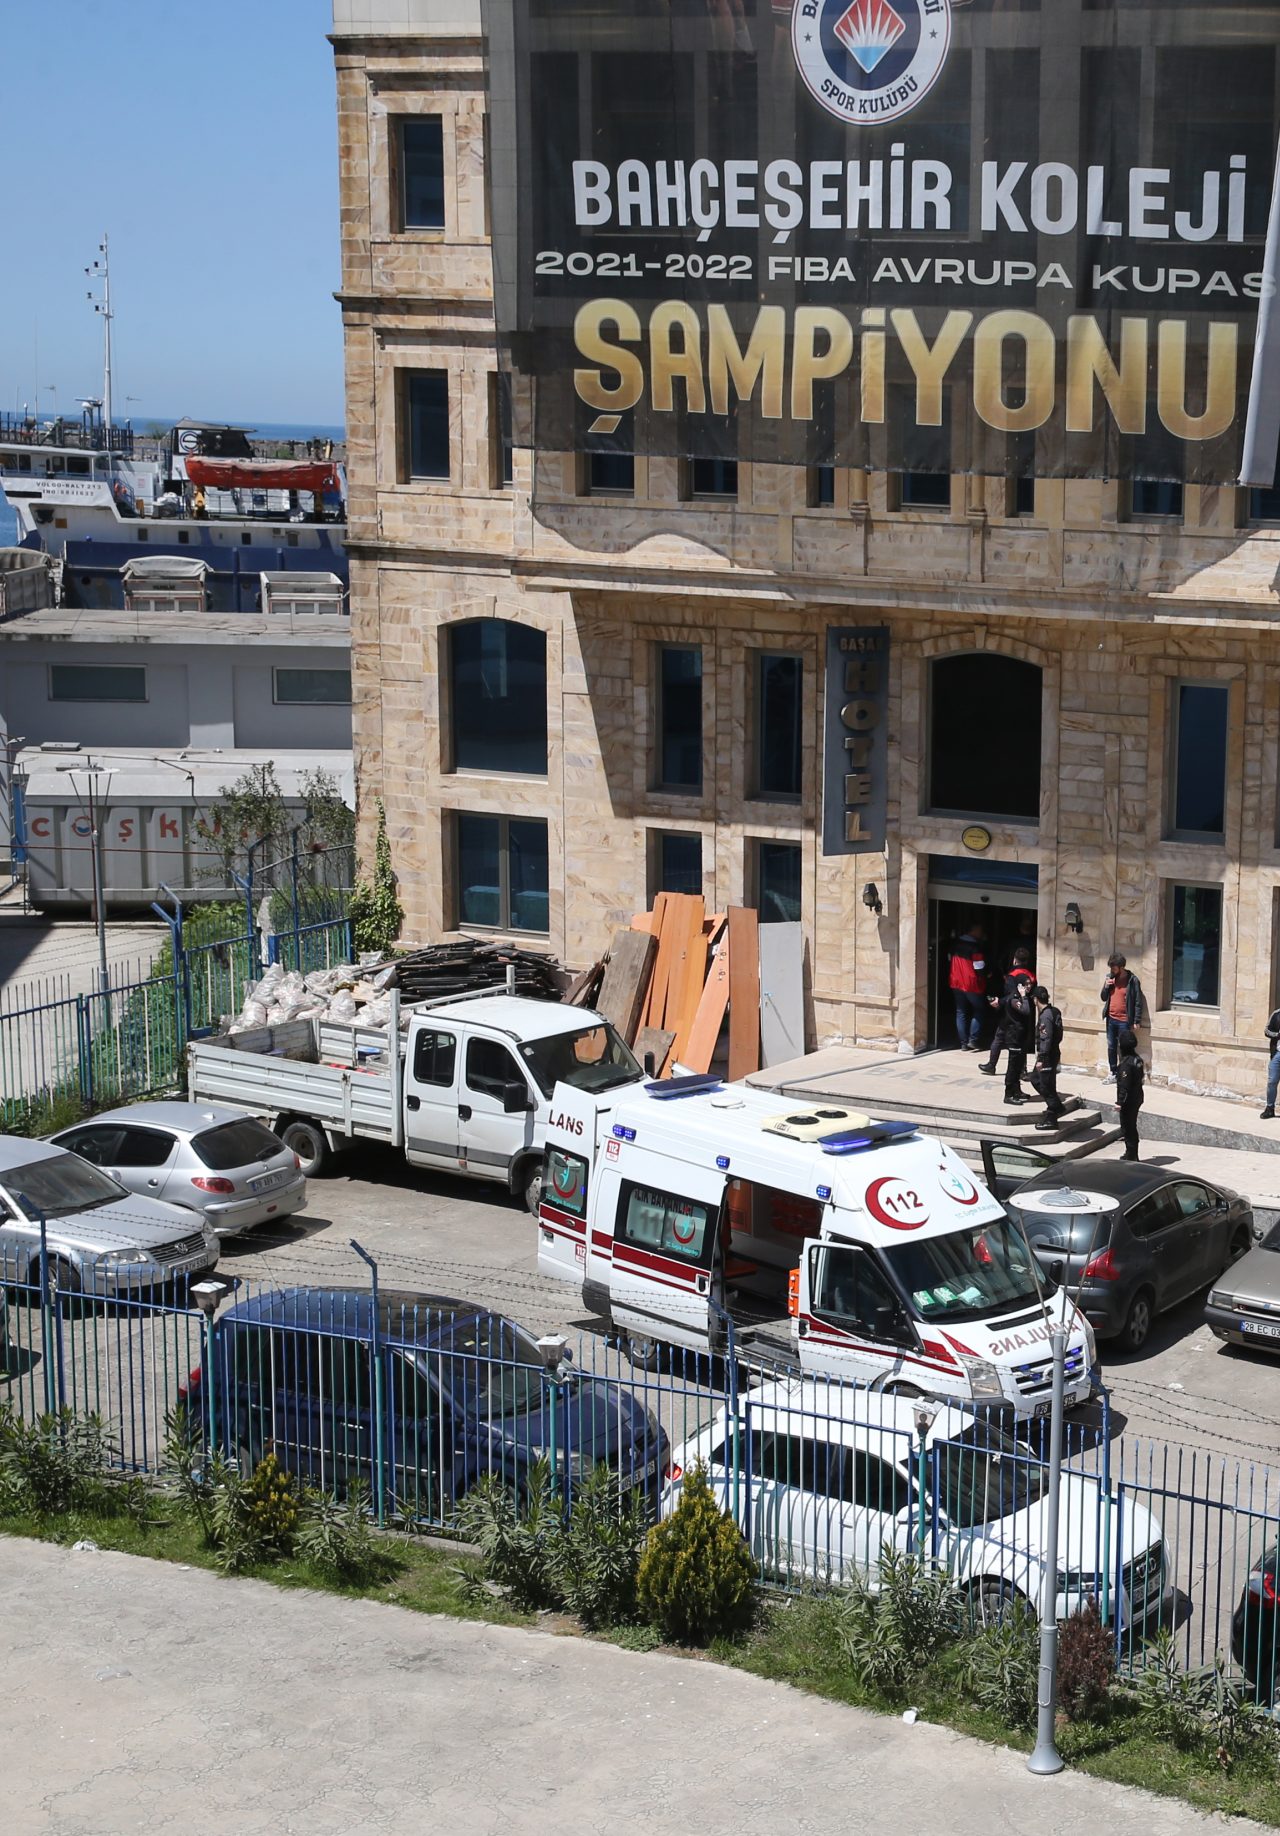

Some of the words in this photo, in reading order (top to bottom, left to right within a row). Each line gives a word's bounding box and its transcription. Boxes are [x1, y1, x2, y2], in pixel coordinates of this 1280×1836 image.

[821, 78, 854, 112] SPOR
[858, 75, 919, 114] KULÜBÜ
[572, 142, 953, 244] BAHÇEŞEHİR
[981, 154, 1247, 243] KOLEJİ
[534, 250, 754, 281] 2021-2022
[767, 256, 856, 283] FIBA
[872, 257, 1074, 289] AVRUPA
[573, 297, 1239, 442] ŞAMPİYONU
[840, 660, 881, 842] HOTEL
[549, 1109, 584, 1135] LANS
[886, 1190, 924, 1213] 112
[1245, 1322, 1254, 1332] 28
[1257, 1325, 1268, 1335] EC
